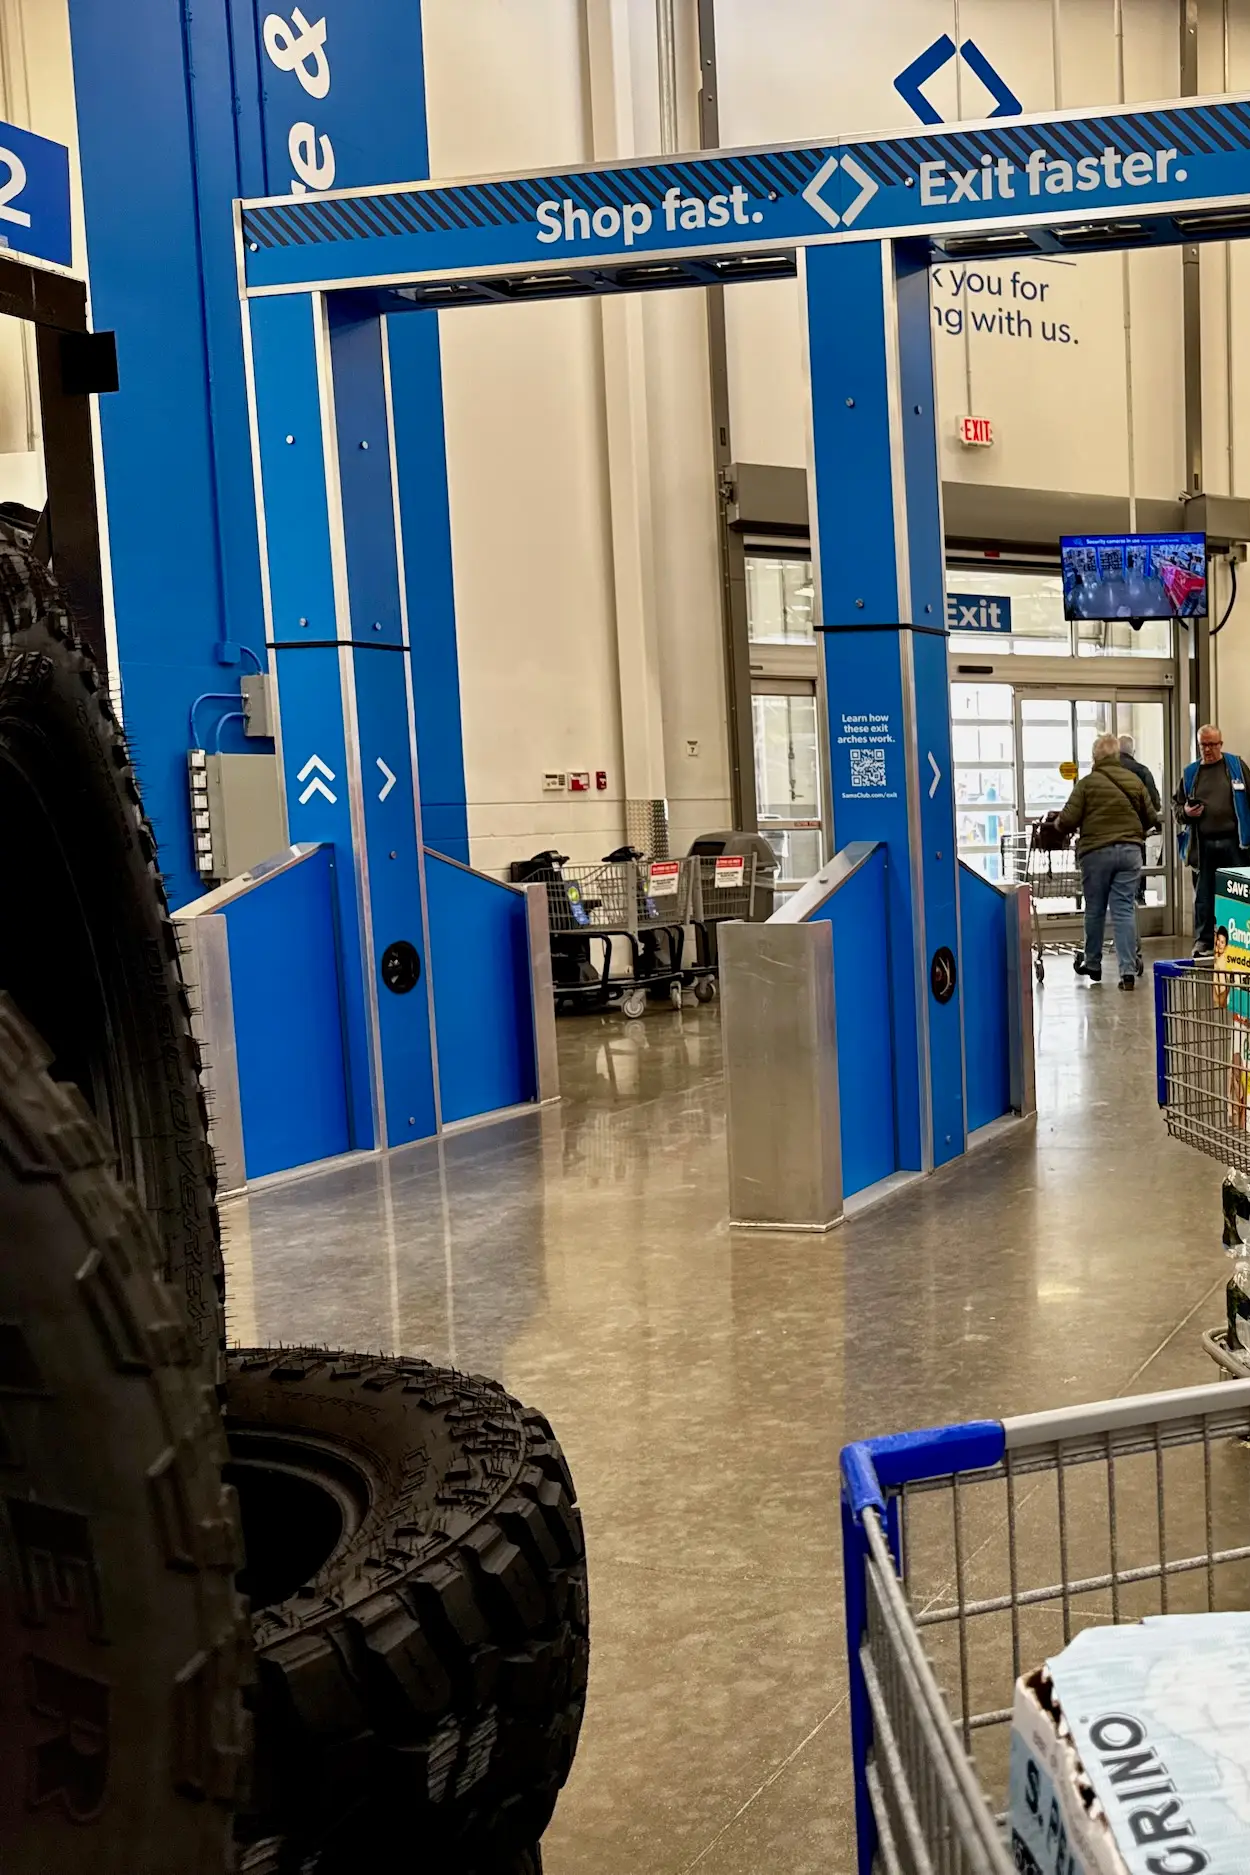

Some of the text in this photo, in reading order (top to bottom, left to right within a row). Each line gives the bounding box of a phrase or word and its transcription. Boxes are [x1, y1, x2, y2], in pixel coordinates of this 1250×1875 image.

[262, 6, 331, 99] &
[919, 147, 1189, 207] Exit faster.
[534, 183, 764, 246] Shop fast.
[950, 269, 1002, 297] you
[1010, 271, 1050, 302] for
[971, 308, 1033, 338] with
[1042, 321, 1079, 345] us.
[964, 419, 991, 442] EXIT
[947, 597, 1002, 629] Exit
[841, 713, 890, 723] Learn how
[843, 723, 889, 734] these exit
[837, 734, 896, 744] arches work.
[1226, 879, 1249, 898] SAVE
